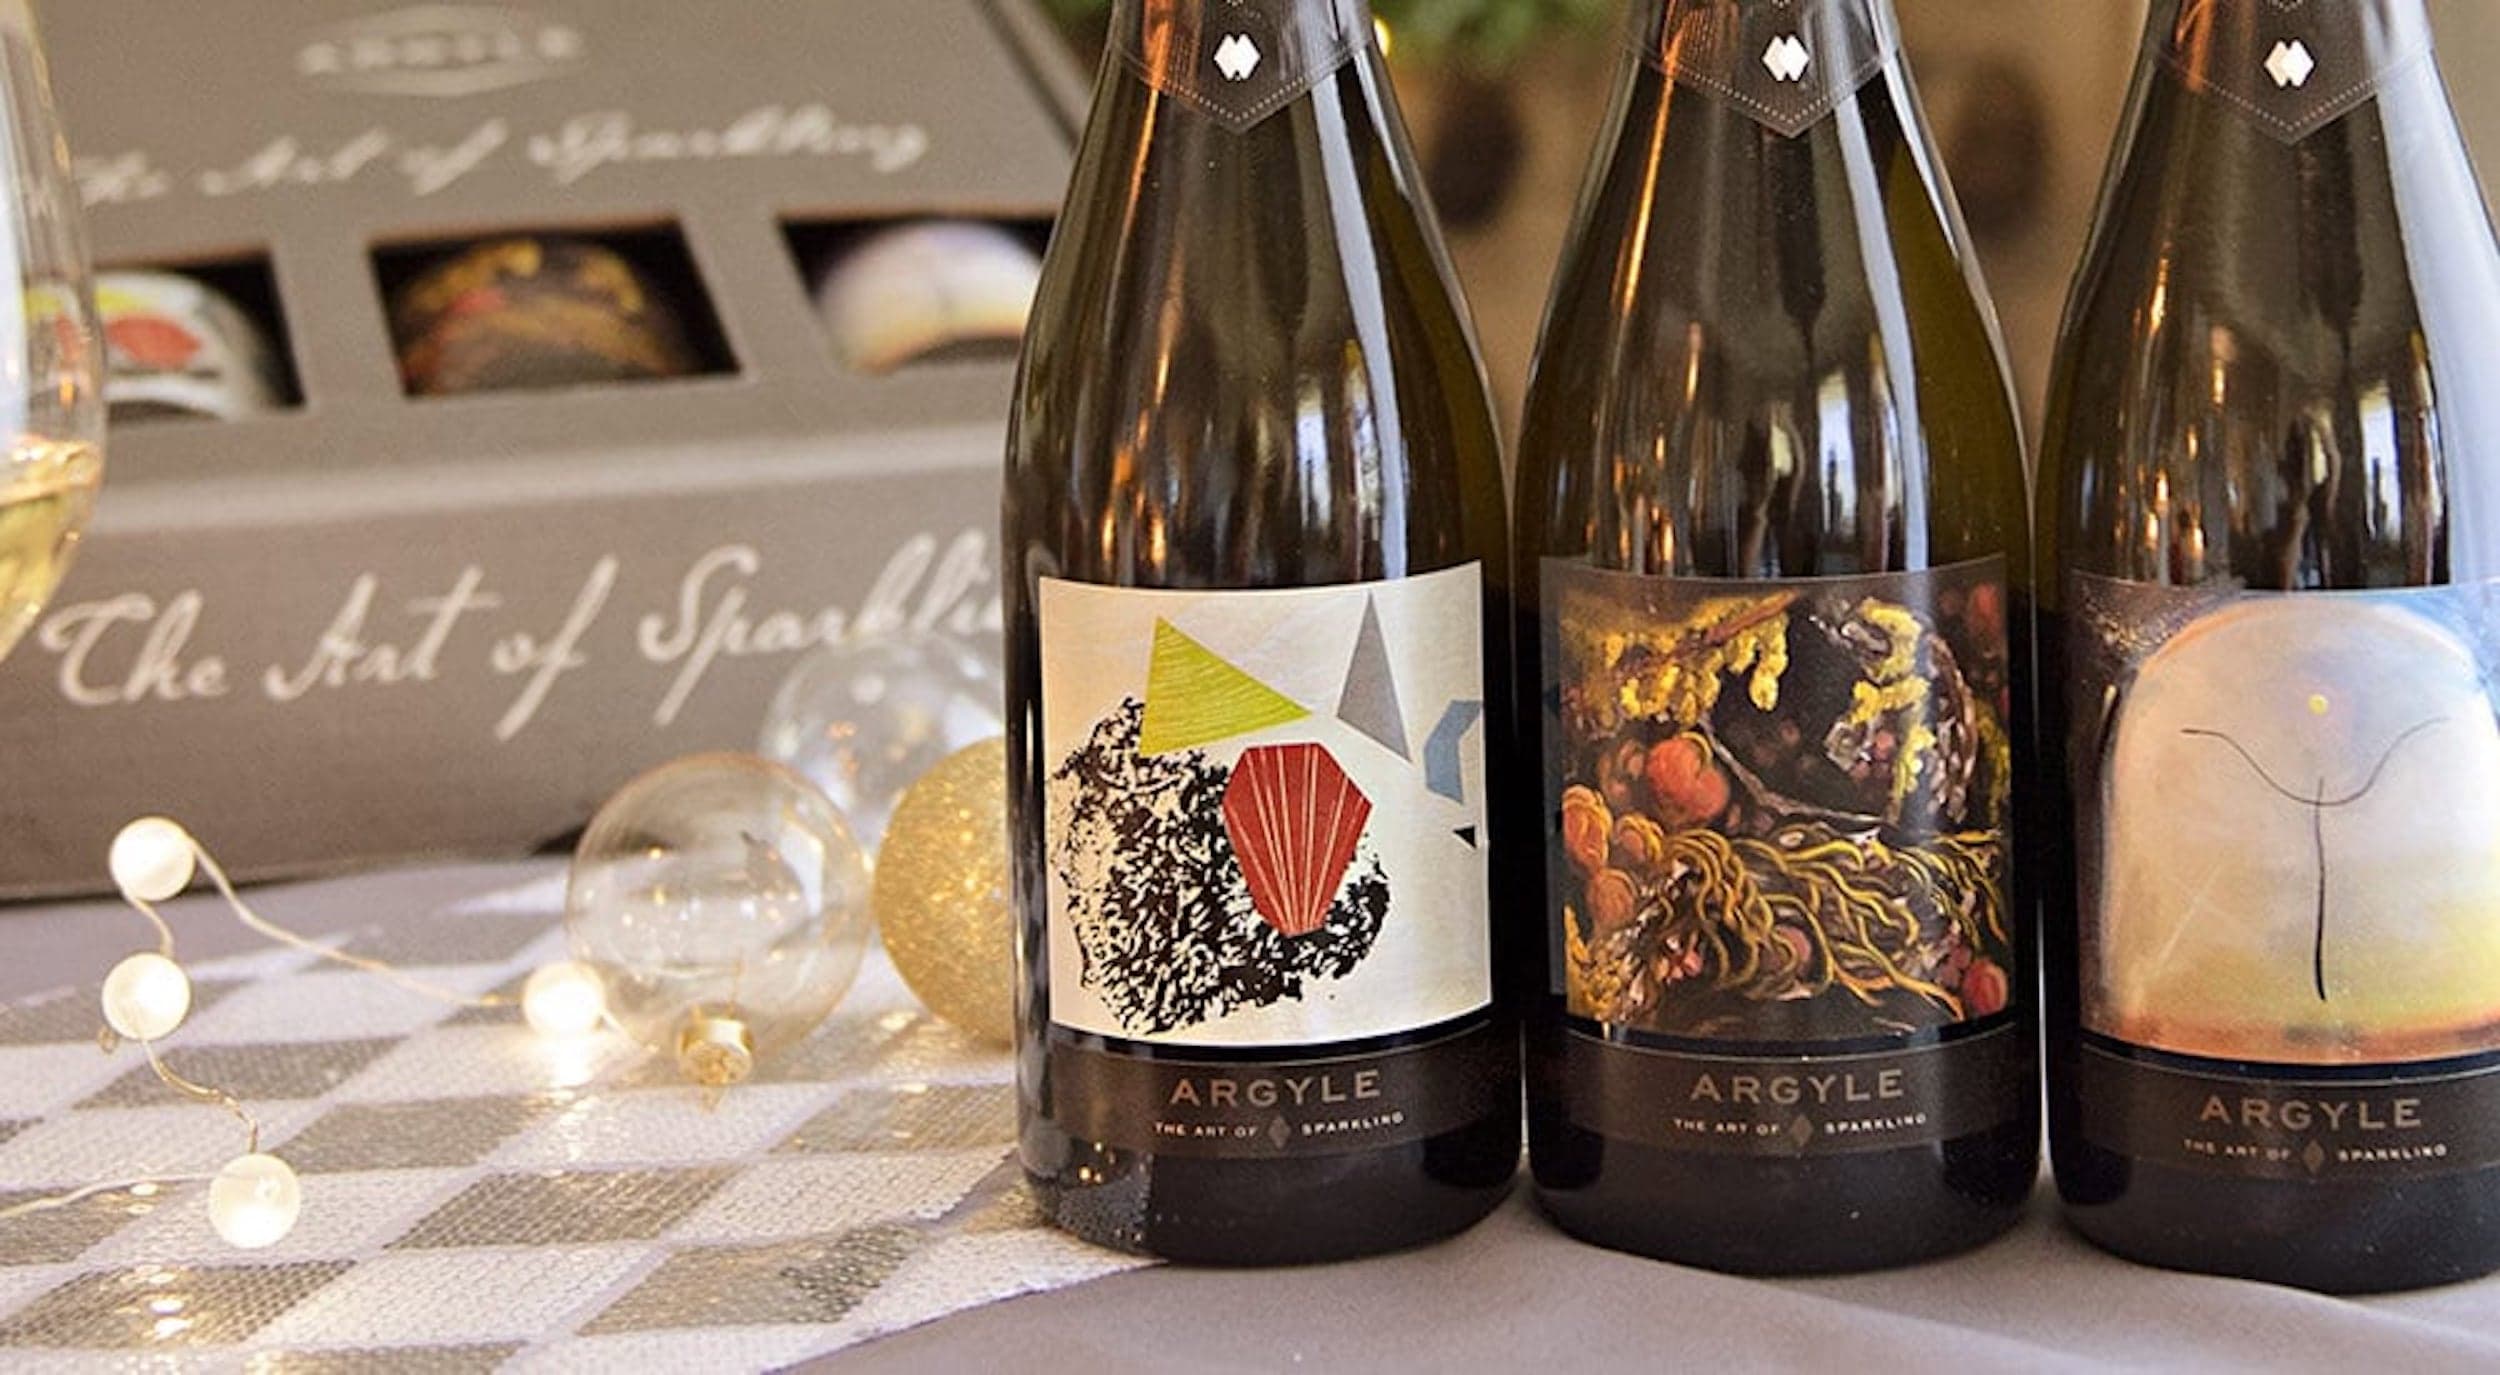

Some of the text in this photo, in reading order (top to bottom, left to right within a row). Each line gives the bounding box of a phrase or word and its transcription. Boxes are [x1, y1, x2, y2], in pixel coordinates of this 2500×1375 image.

[39, 588, 229, 705] The
[265, 564, 500, 700] Art
[492, 554, 619, 741] of
[1169, 1069, 1381, 1107] ARGYLE
[1690, 1068, 1903, 1104] ARGYLE
[1155, 1121, 1185, 1136] THE
[1194, 1122, 1225, 1137] ART
[1234, 1126, 1257, 1138] OF
[1674, 1119, 1704, 1131] THE
[1716, 1121, 1747, 1133] ART
[1756, 1124, 1779, 1136] OF
[2201, 1094, 2421, 1130] ARGYLE
[2184, 1138, 2215, 1154] THE
[2225, 1144, 2257, 1156] ART
